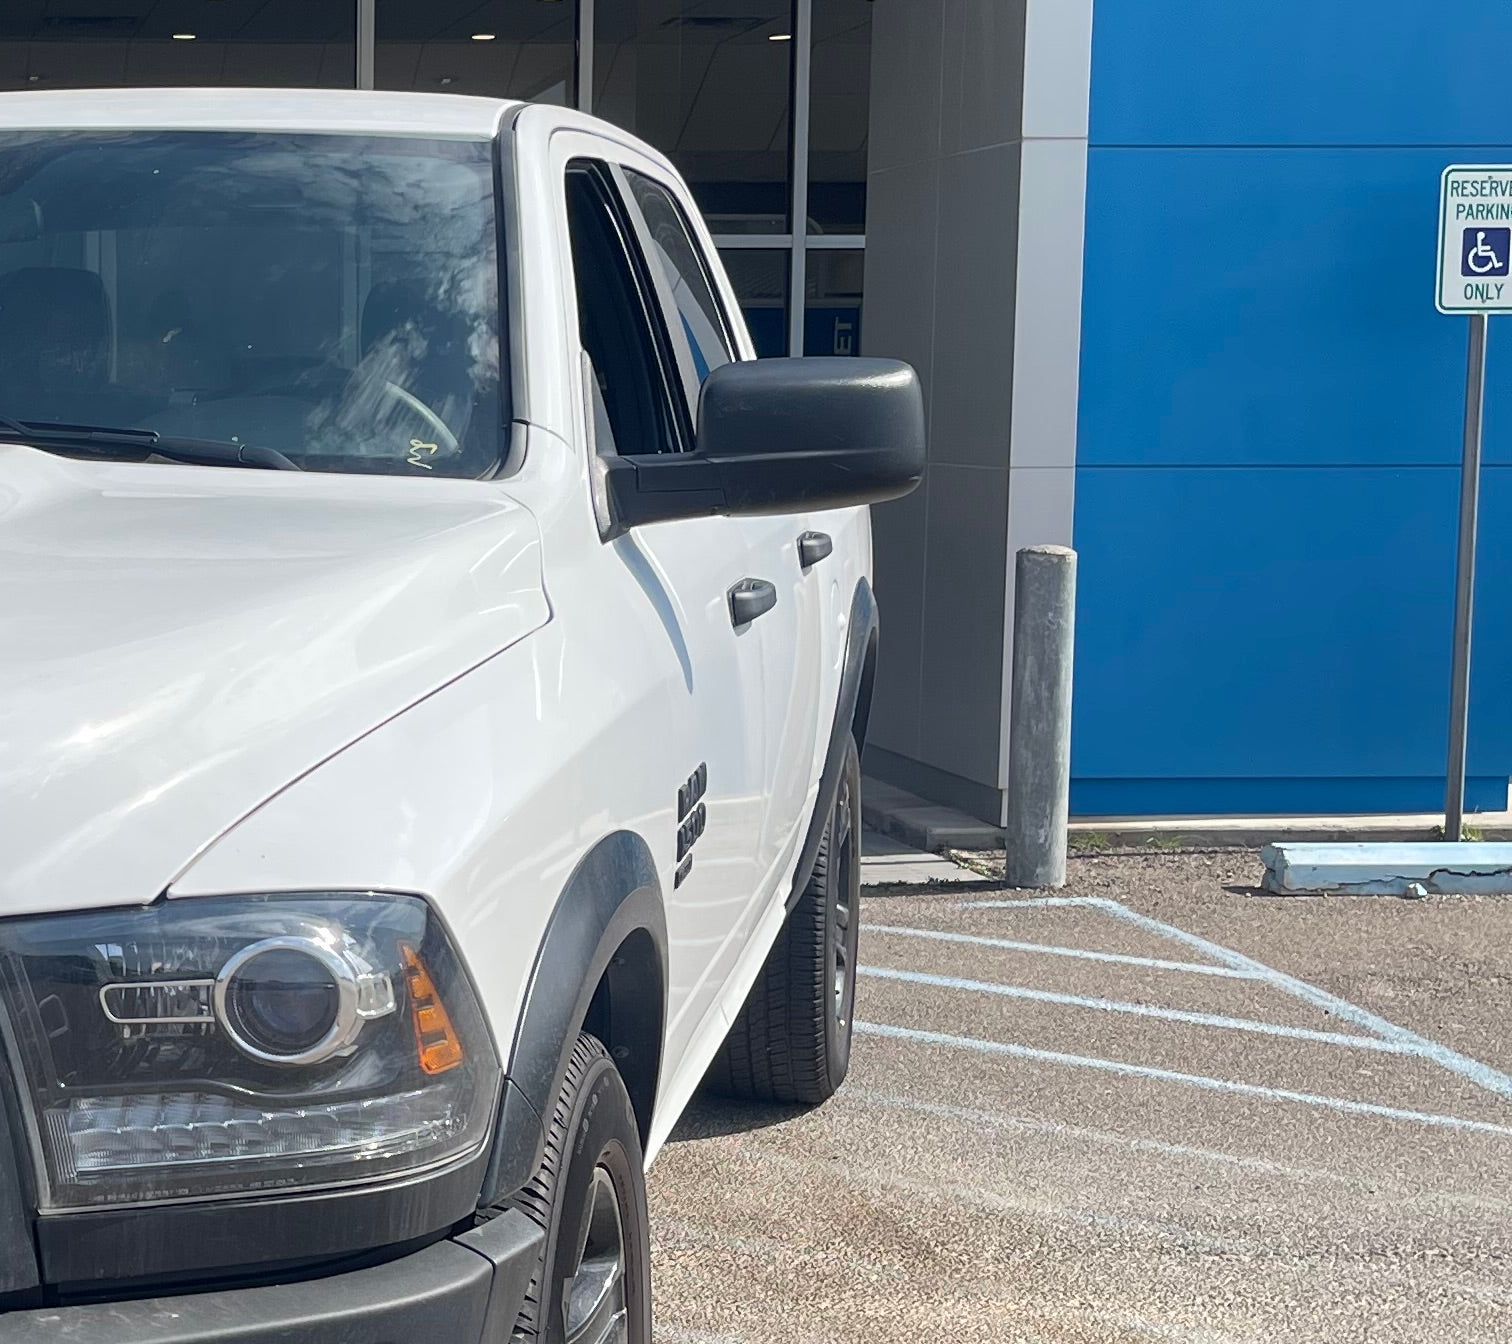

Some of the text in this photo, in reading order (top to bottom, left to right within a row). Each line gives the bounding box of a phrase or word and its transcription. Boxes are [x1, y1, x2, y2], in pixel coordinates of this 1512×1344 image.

[1450, 180, 1512, 197] RESERV
[1456, 203, 1512, 220] PARKIN
[1463, 282, 1504, 300] ONLY
